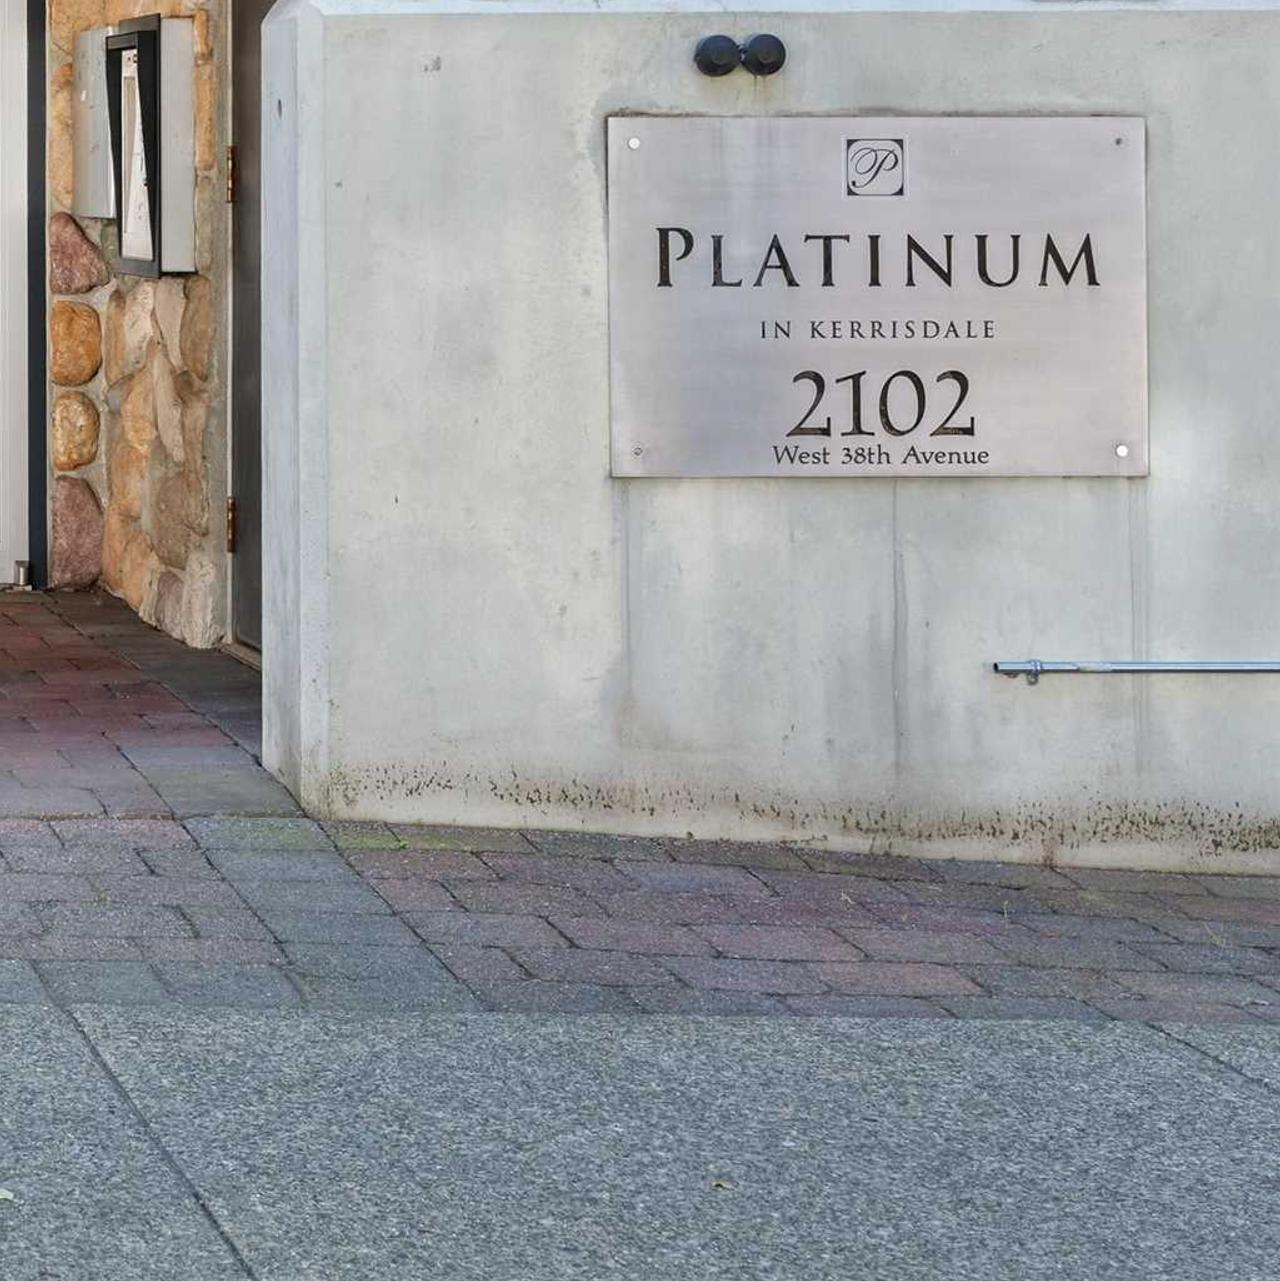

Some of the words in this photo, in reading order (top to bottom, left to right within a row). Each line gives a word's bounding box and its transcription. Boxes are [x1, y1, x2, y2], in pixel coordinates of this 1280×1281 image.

[656, 227, 1101, 288] PLATINUM
[760, 320, 792, 339] IN
[810, 320, 995, 339] KERRISDALE
[785, 369, 975, 438] 2102
[772, 445, 831, 465] West
[841, 444, 891, 465] 38th
[902, 445, 990, 465] Avenue
